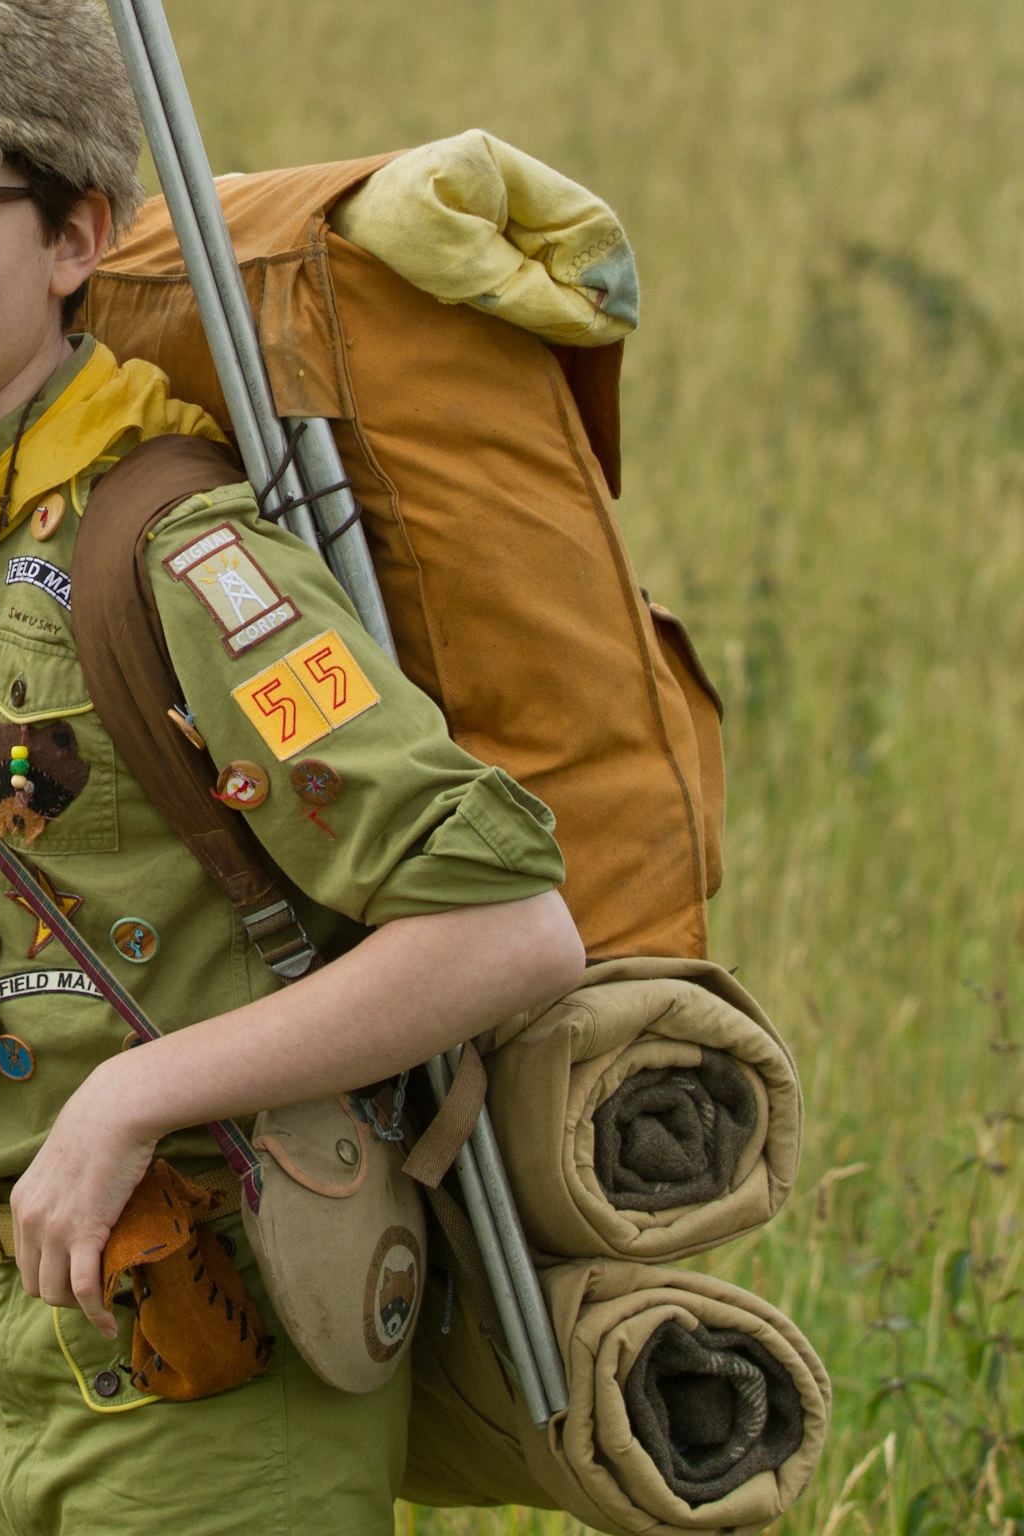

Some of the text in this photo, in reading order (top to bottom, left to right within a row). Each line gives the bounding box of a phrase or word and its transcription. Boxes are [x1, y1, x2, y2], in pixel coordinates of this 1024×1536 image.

[173, 529, 234, 571] SIGNAL
[10, 561, 40, 579] FIELD
[236, 607, 288, 646] CORPS
